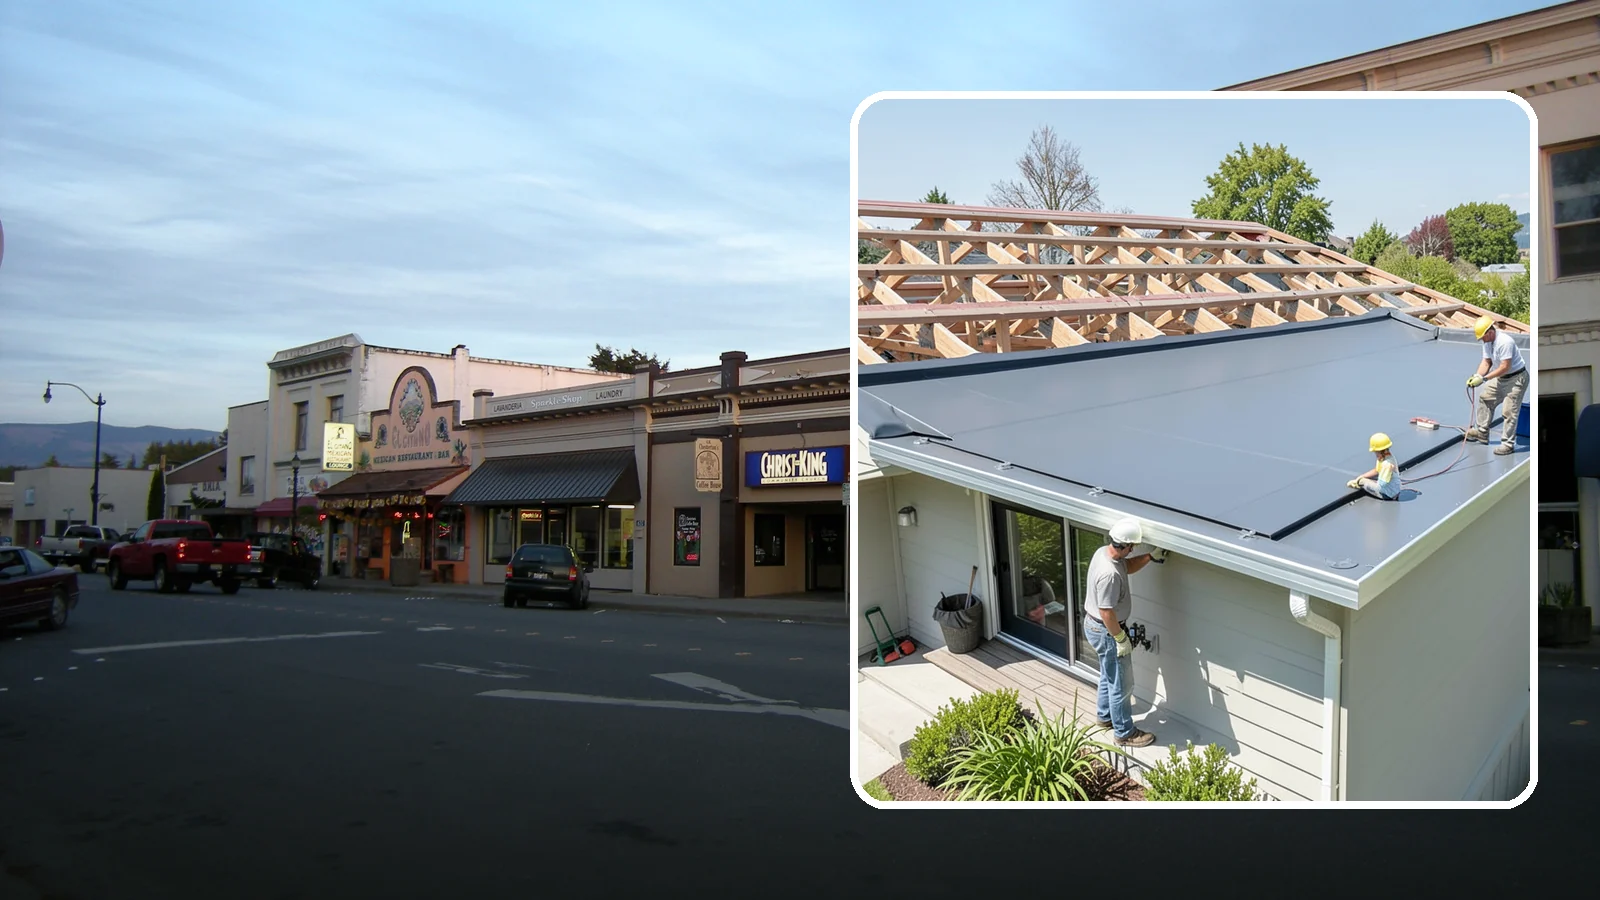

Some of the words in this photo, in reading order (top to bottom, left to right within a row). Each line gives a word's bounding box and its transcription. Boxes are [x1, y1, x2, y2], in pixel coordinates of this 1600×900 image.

[530, 397, 560, 409] Sparkle
[561, 394, 583, 405] Shop
[595, 389, 623, 400] LAUNDRY
[493, 402, 522, 413] LAVANDERIA
[392, 425, 402, 449] EL
[374, 453, 396, 464] MEXICAN
[397, 451, 433, 462] RESTAURANT
[438, 450, 450, 459] BAR
[760, 452, 797, 478] CHRIST
[799, 450, 827, 476] KING
[696, 480, 709, 489] Coffee
[710, 480, 721, 489] House
